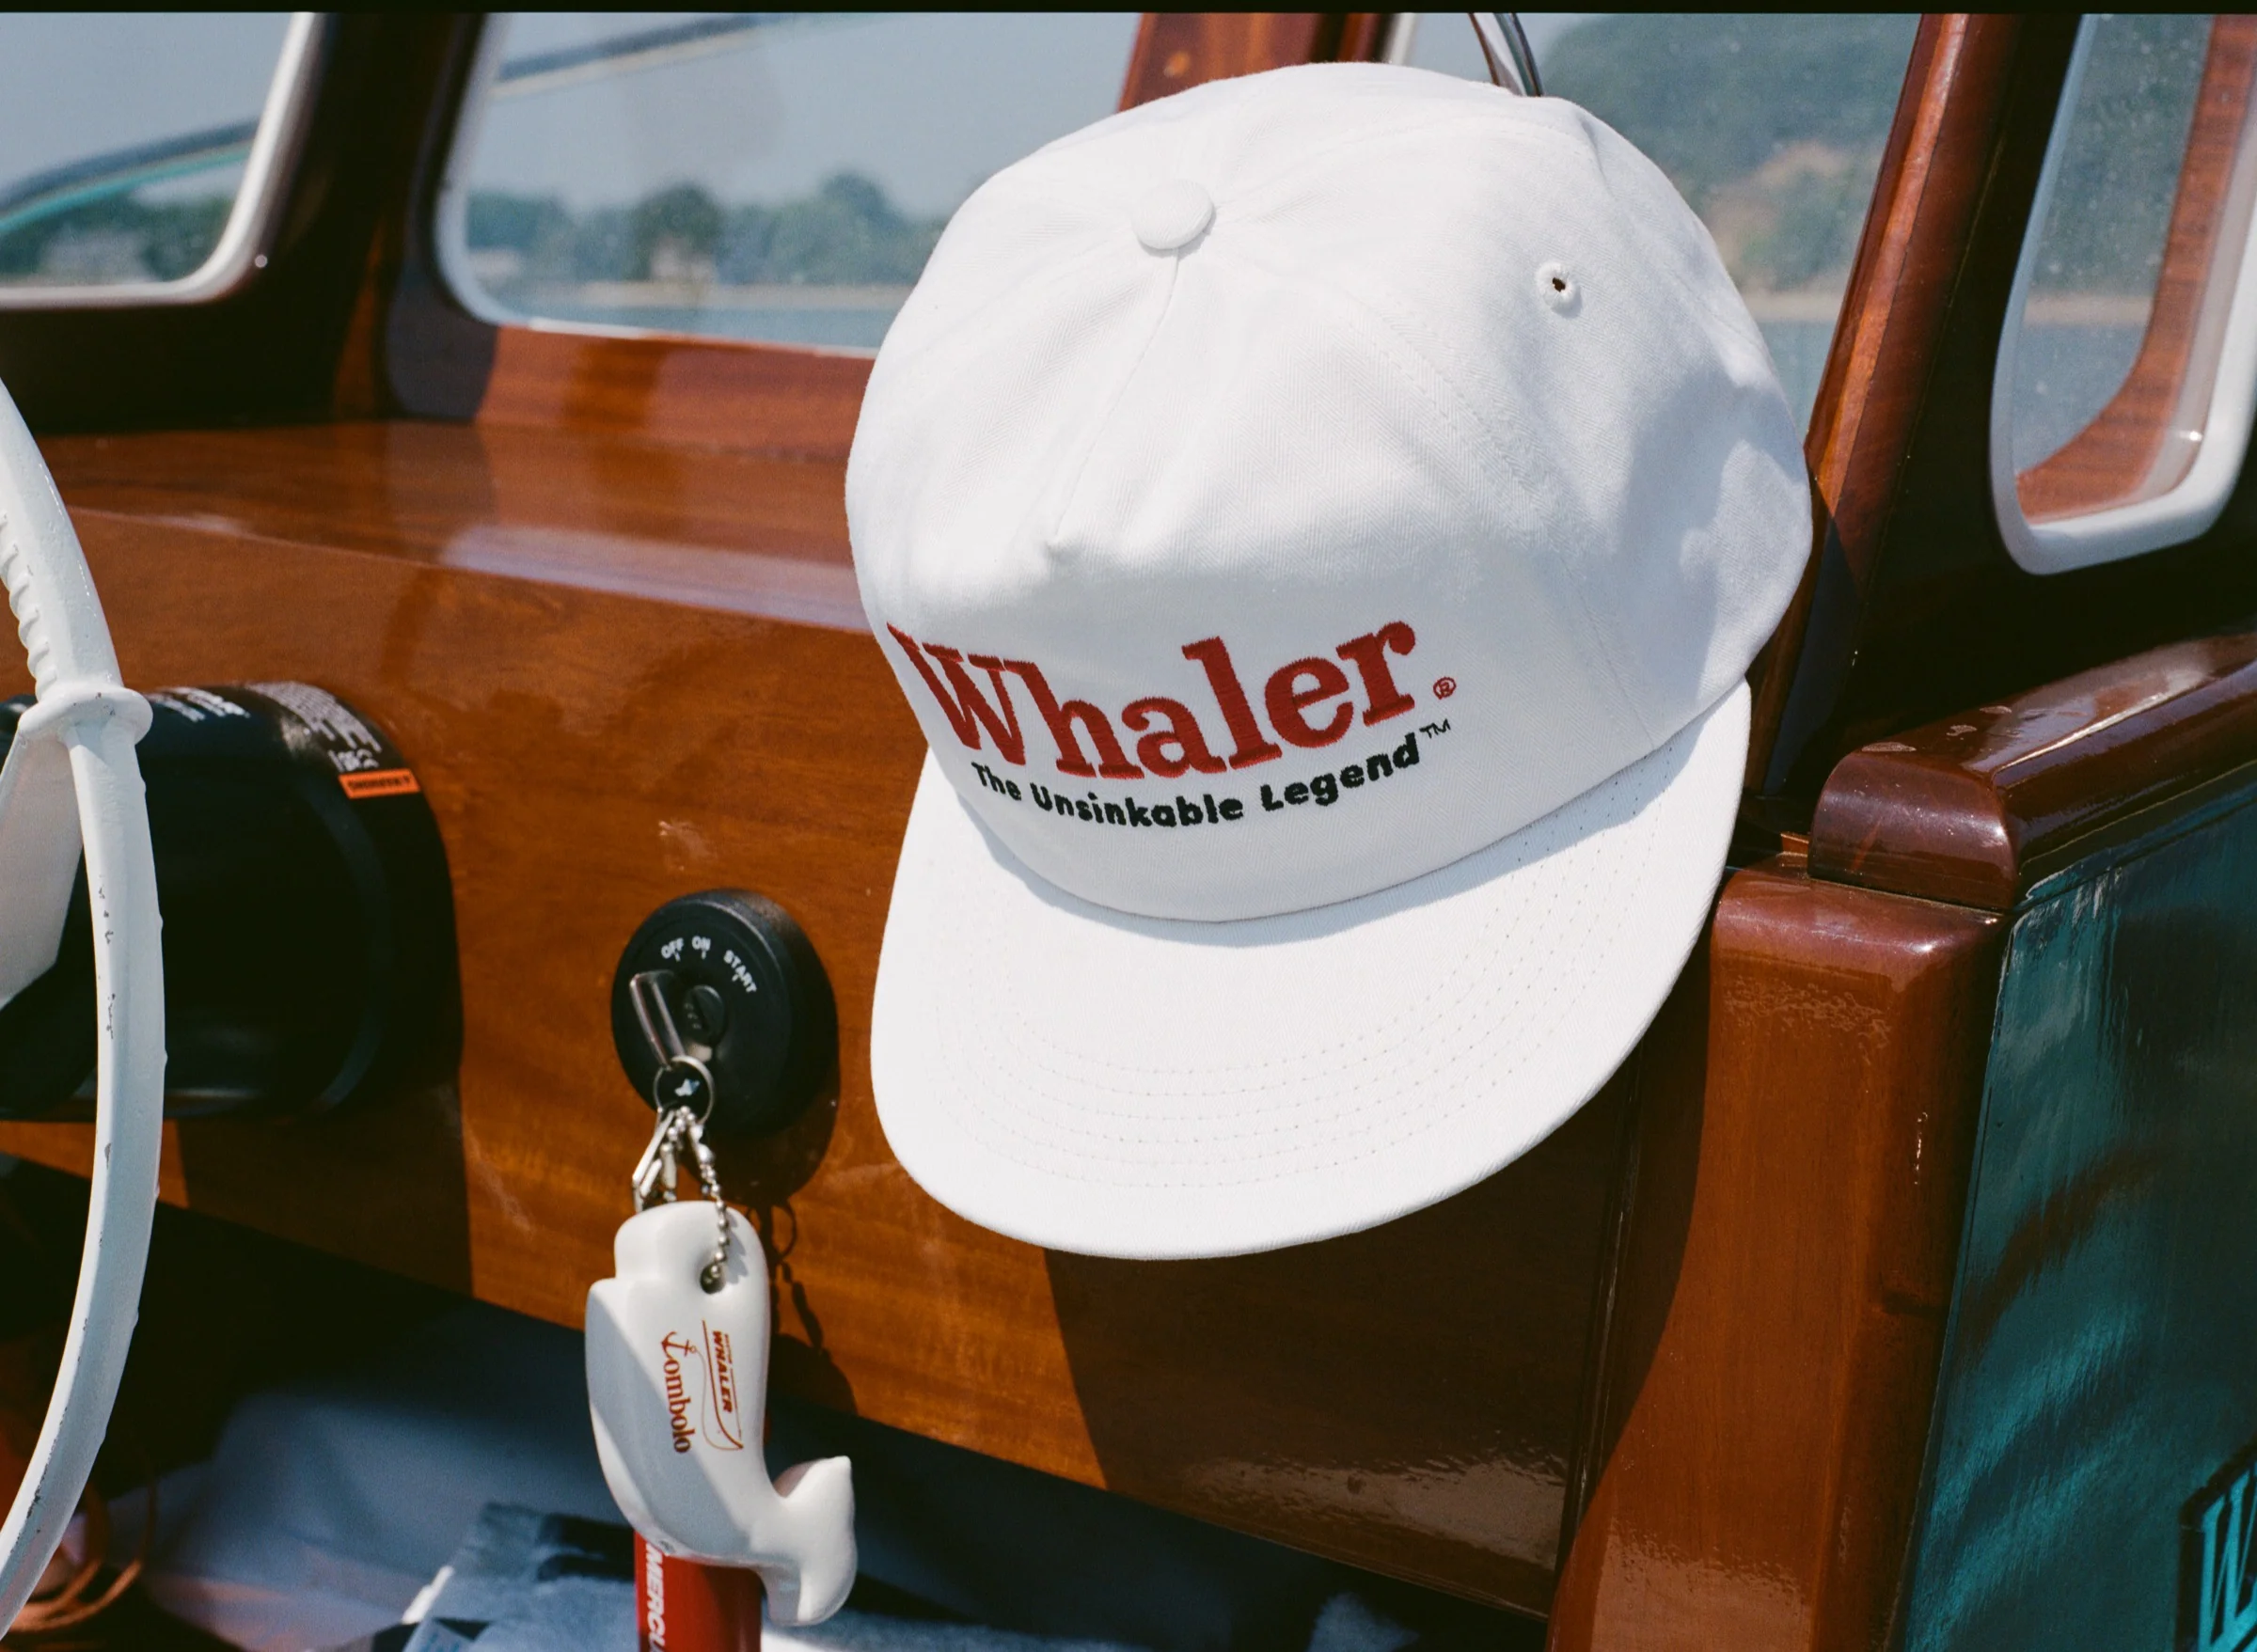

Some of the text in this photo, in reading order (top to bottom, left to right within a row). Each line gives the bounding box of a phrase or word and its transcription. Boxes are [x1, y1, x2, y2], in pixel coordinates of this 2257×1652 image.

[971, 763, 1023, 801] The
[1030, 783, 1243, 827] Unsinkable
[661, 936, 757, 993] OFF ON START
[712, 1329, 734, 1413] WHALER
